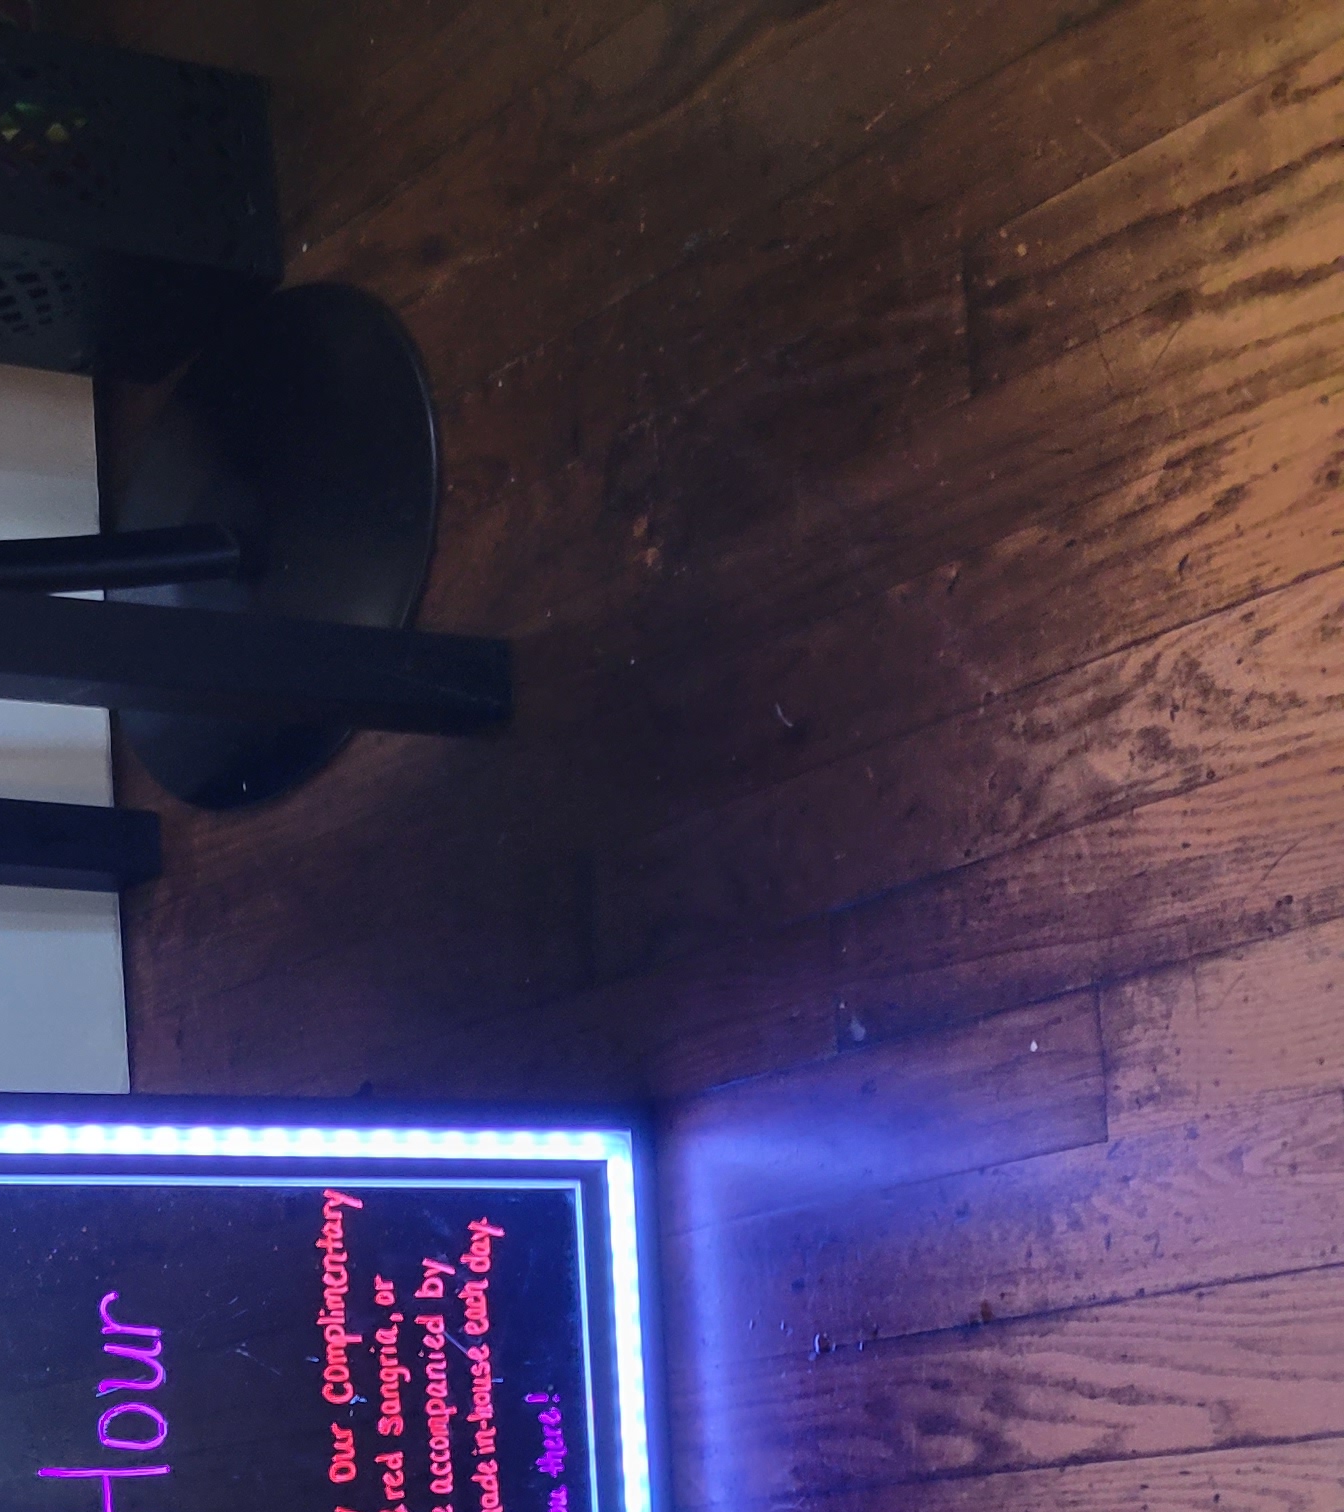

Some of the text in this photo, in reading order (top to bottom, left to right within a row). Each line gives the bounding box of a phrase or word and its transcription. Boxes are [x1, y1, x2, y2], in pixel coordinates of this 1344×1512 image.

[373, 1273, 396, 1306] or
[413, 1256, 456, 1299] by
[455, 1276, 491, 1337] each
[413, 1313, 458, 1494] accompanied
[464, 1341, 500, 1456] in-house
[523, 1390, 571, 1479] there!
[374, 1450, 406, 1501] red
